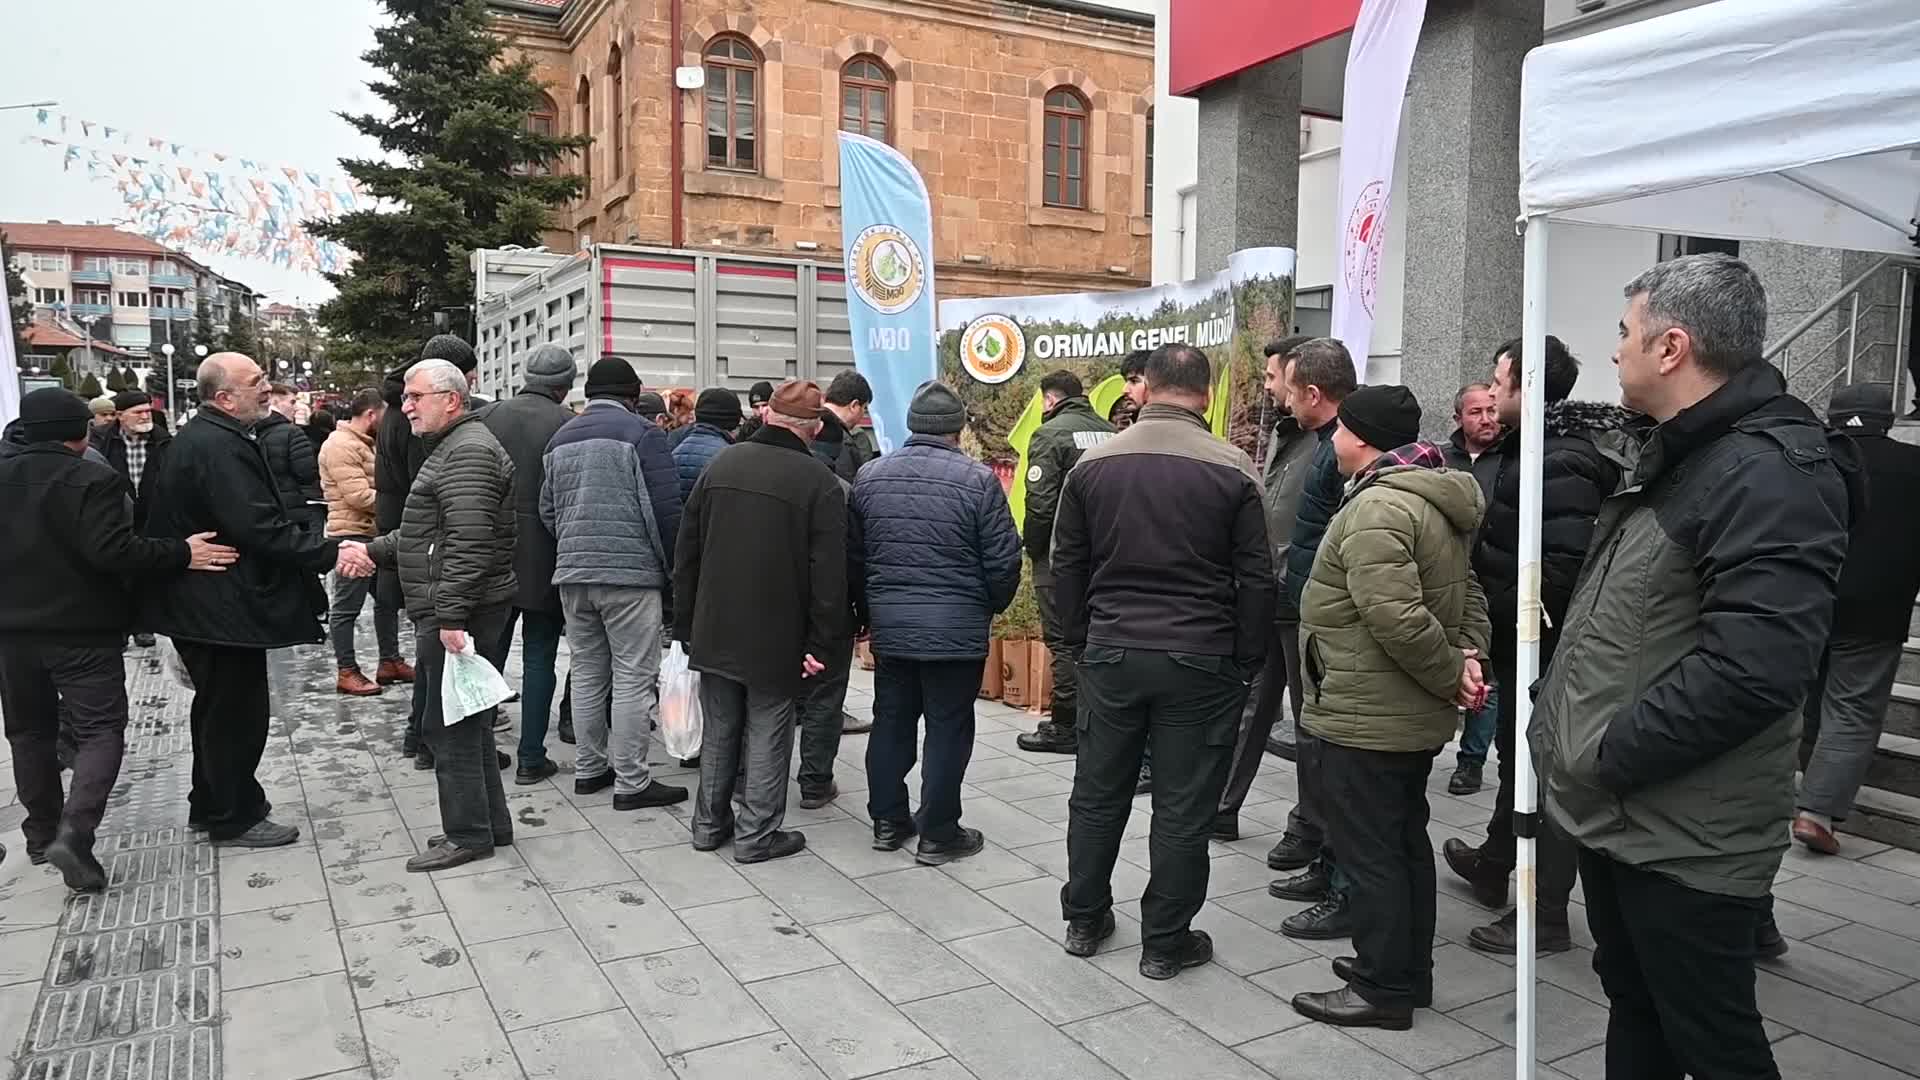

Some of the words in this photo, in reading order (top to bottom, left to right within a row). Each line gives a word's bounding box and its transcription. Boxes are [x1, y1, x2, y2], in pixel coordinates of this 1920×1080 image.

[1033, 331, 1125, 359] ORMAN
[1131, 324, 1193, 351] GENEL
[1196, 297, 1235, 348] MÜDÜ
